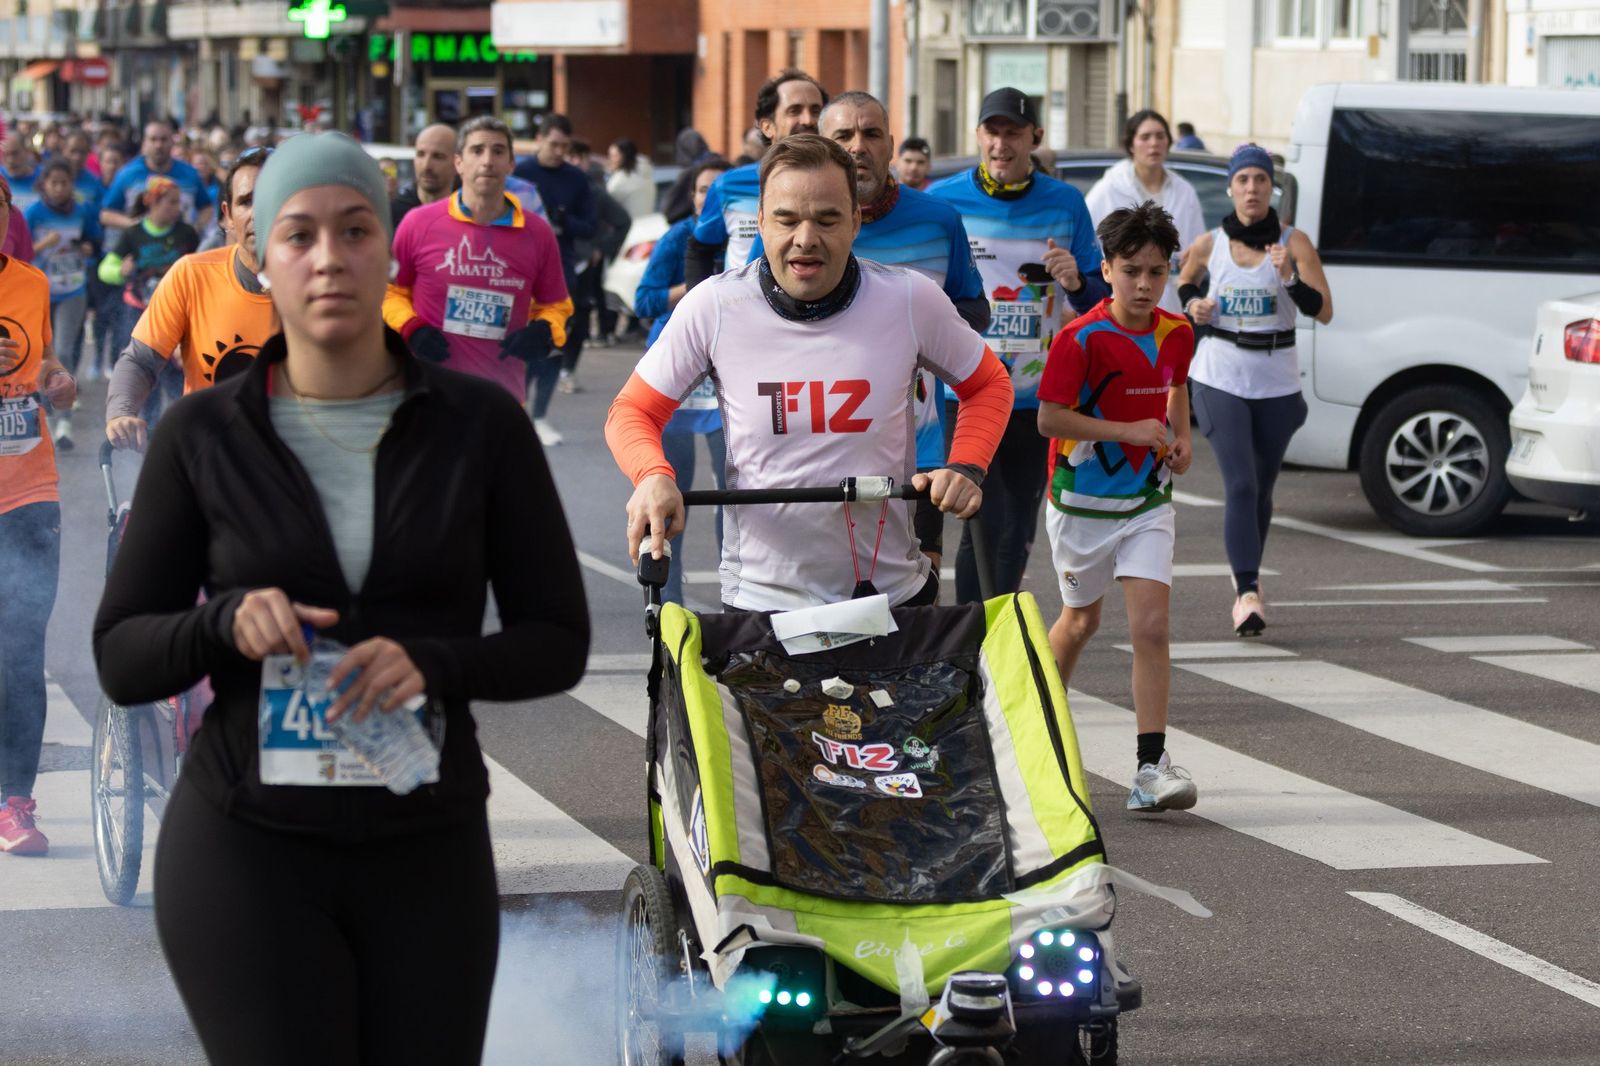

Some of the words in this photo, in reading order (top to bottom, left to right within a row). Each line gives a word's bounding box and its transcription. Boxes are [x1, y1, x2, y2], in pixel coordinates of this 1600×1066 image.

[457, 265, 504, 277] MATIS
[489, 278, 525, 290] running
[466, 290, 505, 304] SETEL
[1233, 288, 1270, 296] SETEL
[453, 301, 496, 324] 2943
[998, 304, 1037, 313] SETEL
[1226, 296, 1263, 315] 2440
[987, 316, 1030, 336] 2540
[775, 390, 783, 432] TRANSPORTES
